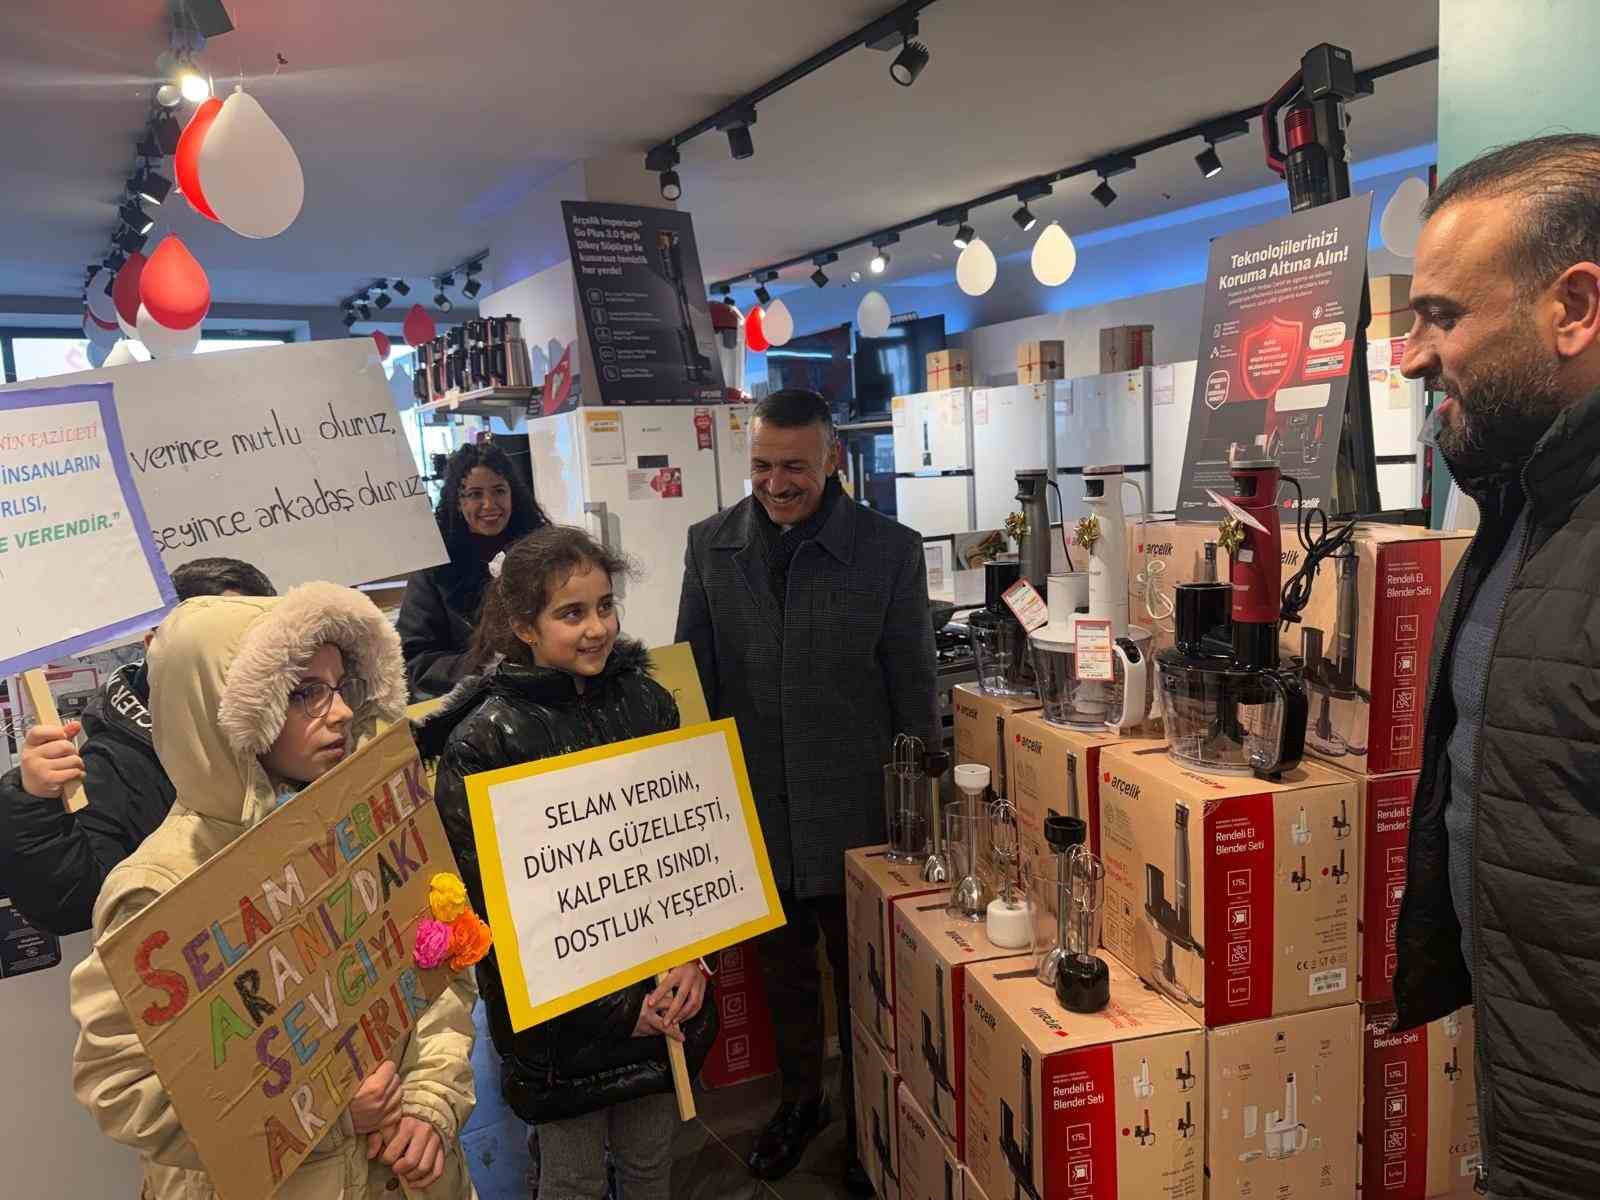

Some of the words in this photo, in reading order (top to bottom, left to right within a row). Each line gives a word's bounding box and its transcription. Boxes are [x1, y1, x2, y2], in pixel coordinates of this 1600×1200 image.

[1231, 227, 1338, 269] Teknolojilerinizi
[1219, 267, 1266, 290] Koruma
[1269, 257, 1311, 278] Altına
[1314, 245, 1349, 268] Alın!
[130, 439, 223, 472] verince
[232, 408, 302, 455] mutlu
[319, 402, 396, 440] oluruz,
[1, 454, 101, 484] İNSANLARIN
[254, 478, 354, 529] arkadaş
[1386, 586, 1416, 598] Blender
[1416, 584, 1432, 596] Seti
[1387, 573, 1415, 585] Rendeli
[545, 791, 617, 829] SELAM
[620, 770, 700, 807] VERDİM,
[1111, 776, 1140, 801] arçelik
[523, 837, 603, 879] DÜNYA
[608, 796, 730, 852] GÜZELLEŞTİ,
[1216, 828, 1246, 842] Rendeli
[1247, 827, 1255, 838] El
[1377, 821, 1406, 833] Blender
[1216, 843, 1247, 855] Blender
[1248, 840, 1264, 851] Seti
[134, 863, 305, 1027] SELAM
[309, 759, 434, 879] VERMEK
[557, 863, 652, 914] KALPLER
[656, 843, 720, 880] ISINDI,
[554, 904, 654, 960] DOSTLUK
[658, 870, 744, 918] YEŞERDİ.
[209, 819, 430, 1070] ARANIZDAKİ
[1374, 1036, 1402, 1049] Blender
[1403, 1032, 1418, 1044] Seti
[1053, 1083, 1085, 1097] Rendeli
[1086, 1081, 1094, 1092] El
[1053, 1097, 1085, 1110] Blender
[1087, 1094, 1104, 1106] Seti
